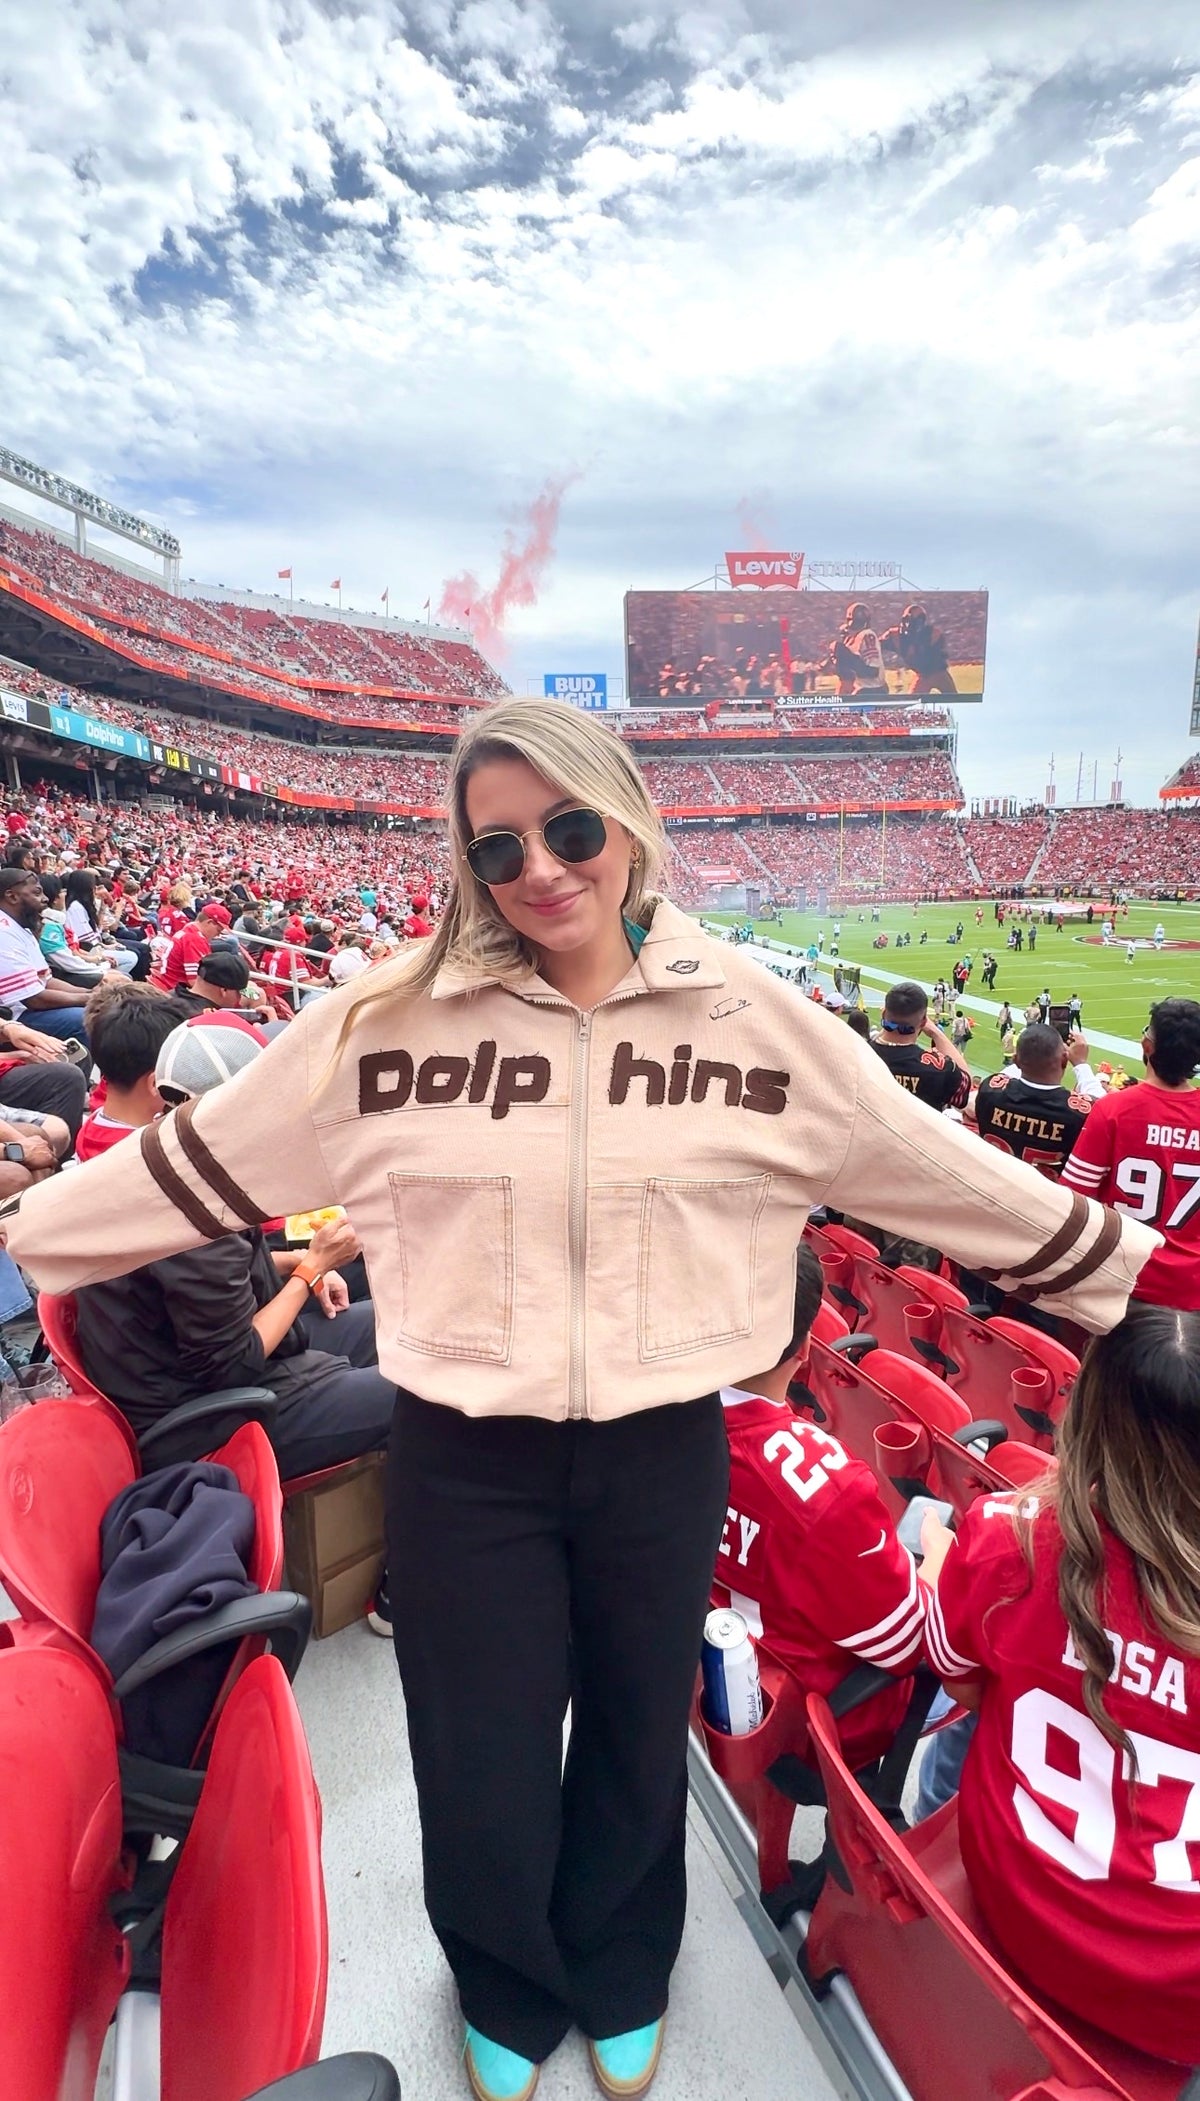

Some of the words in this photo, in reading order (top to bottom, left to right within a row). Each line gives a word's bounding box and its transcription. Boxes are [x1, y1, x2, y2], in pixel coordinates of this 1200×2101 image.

[808, 561, 897, 577] STADIUM
[555, 677, 596, 692] BUD
[786, 696, 813, 705] Sutter
[814, 695, 843, 704] Health
[85, 720, 125, 747] Dolphins
[990, 1107, 1065, 1142] KITTLE
[1145, 1123, 1200, 1152] BOSA
[1114, 1156, 1200, 1228] 97
[763, 1421, 851, 1502] 23
[1011, 1687, 1200, 1893] 97
